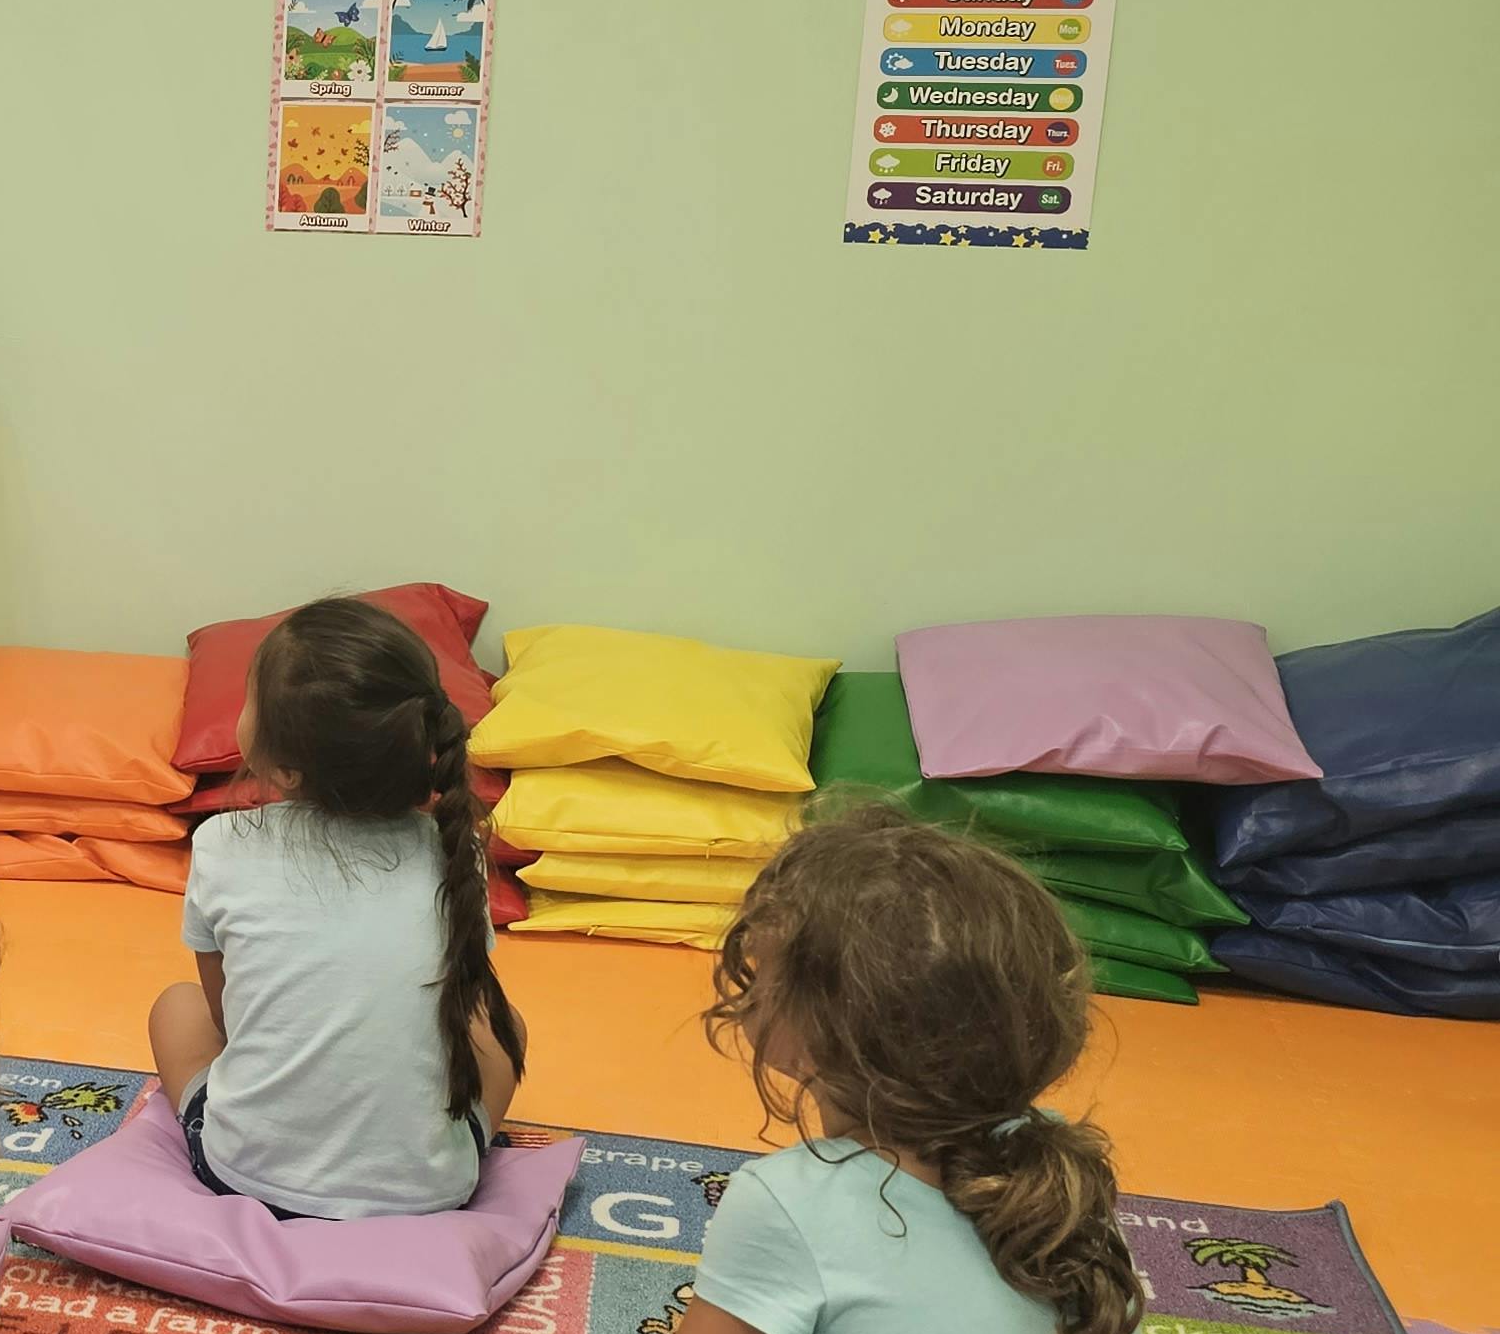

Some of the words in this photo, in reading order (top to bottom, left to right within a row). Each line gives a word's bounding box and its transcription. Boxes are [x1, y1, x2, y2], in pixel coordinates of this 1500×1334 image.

[939, 16, 1036, 41] Monday
[934, 51, 1033, 75] Tuesday
[310, 82, 351, 97] Spring
[408, 83, 464, 96] Summer
[909, 86, 1039, 110] Wednesday
[920, 119, 1032, 144] Thursday
[935, 153, 1011, 177] Friday
[1045, 160, 1063, 173] Fri.
[915, 186, 1023, 211] Saturday
[1041, 194, 1060, 205] Sat.
[299, 215, 348, 228] Autumn
[408, 218, 450, 232] Winter
[3, 1128, 55, 1153] d
[581, 1148, 704, 1172] grape
[590, 1191, 680, 1239] G
[1118, 1211, 1210, 1234] and
[5, 1265, 77, 1288] Old
[105, 1306, 138, 1325] a
